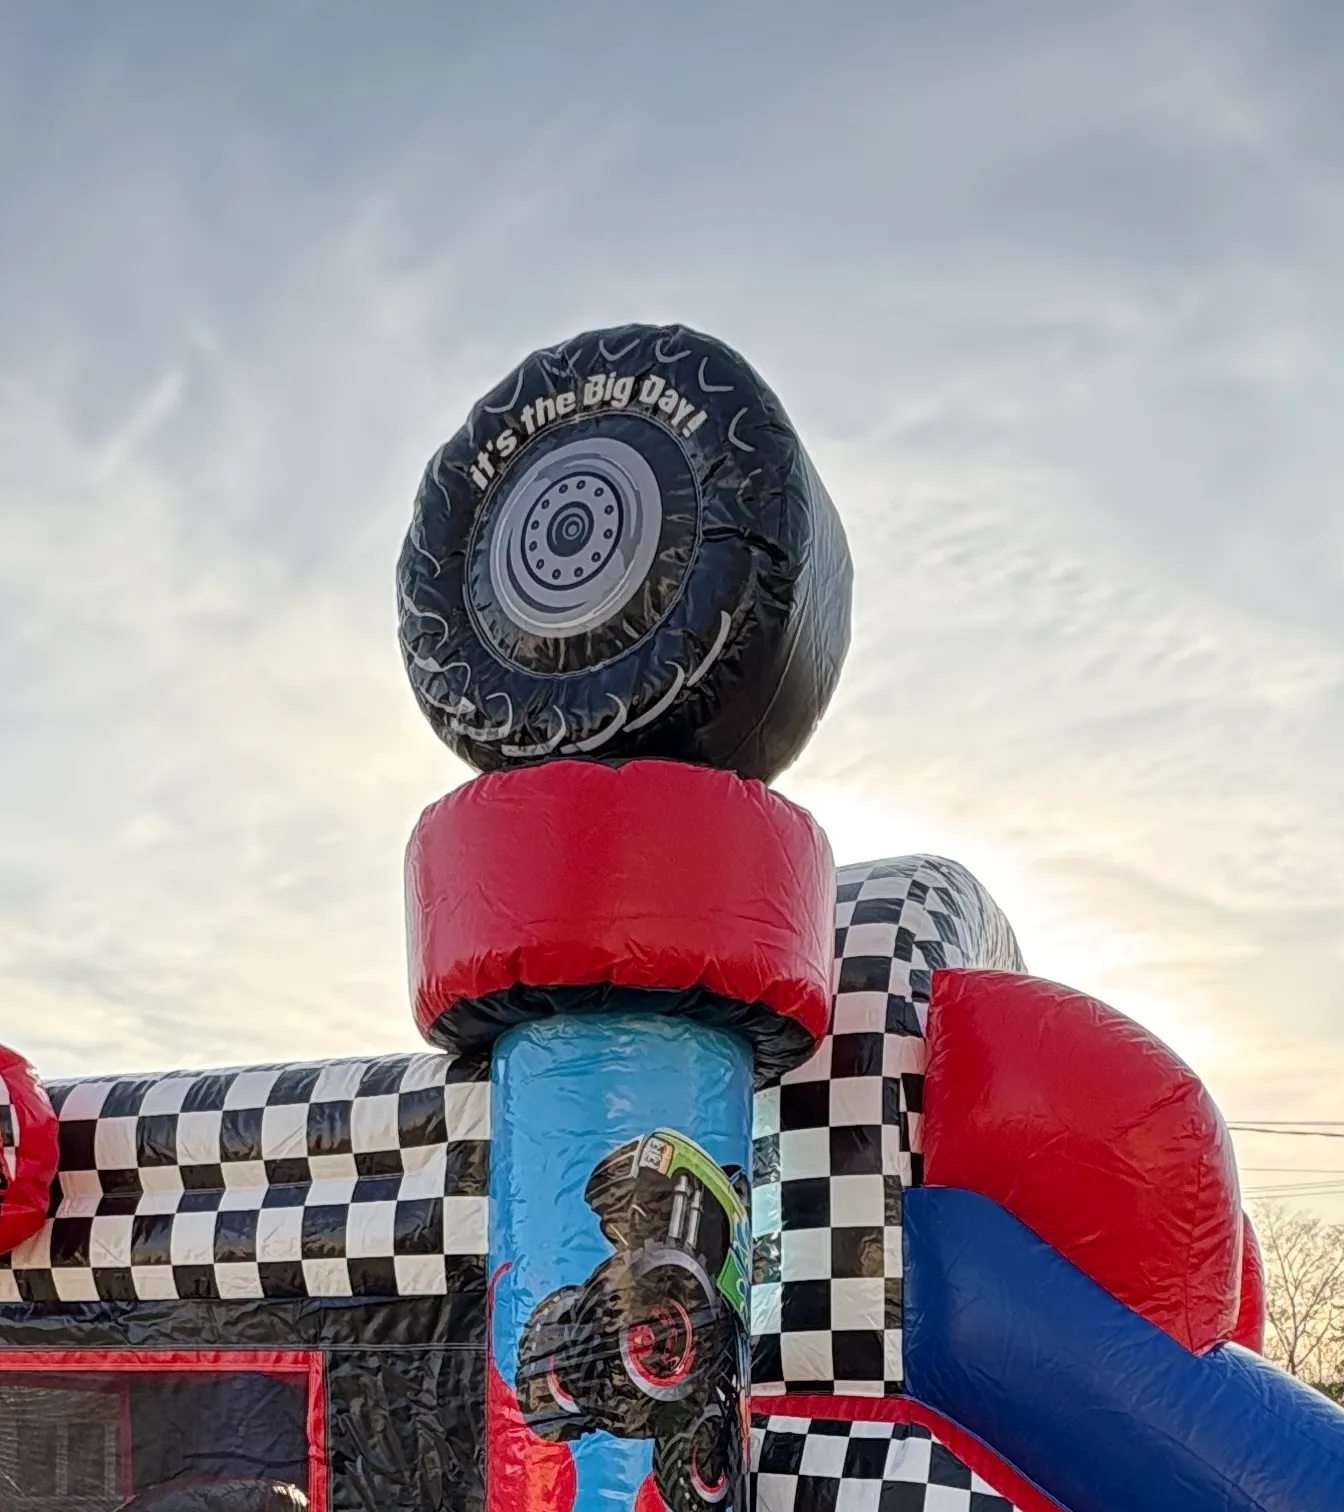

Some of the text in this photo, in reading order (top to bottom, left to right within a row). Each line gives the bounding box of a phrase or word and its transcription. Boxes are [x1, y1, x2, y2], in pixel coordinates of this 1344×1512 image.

[520, 391, 577, 436] the
[583, 371, 635, 408] Big
[639, 374, 709, 439] Day!
